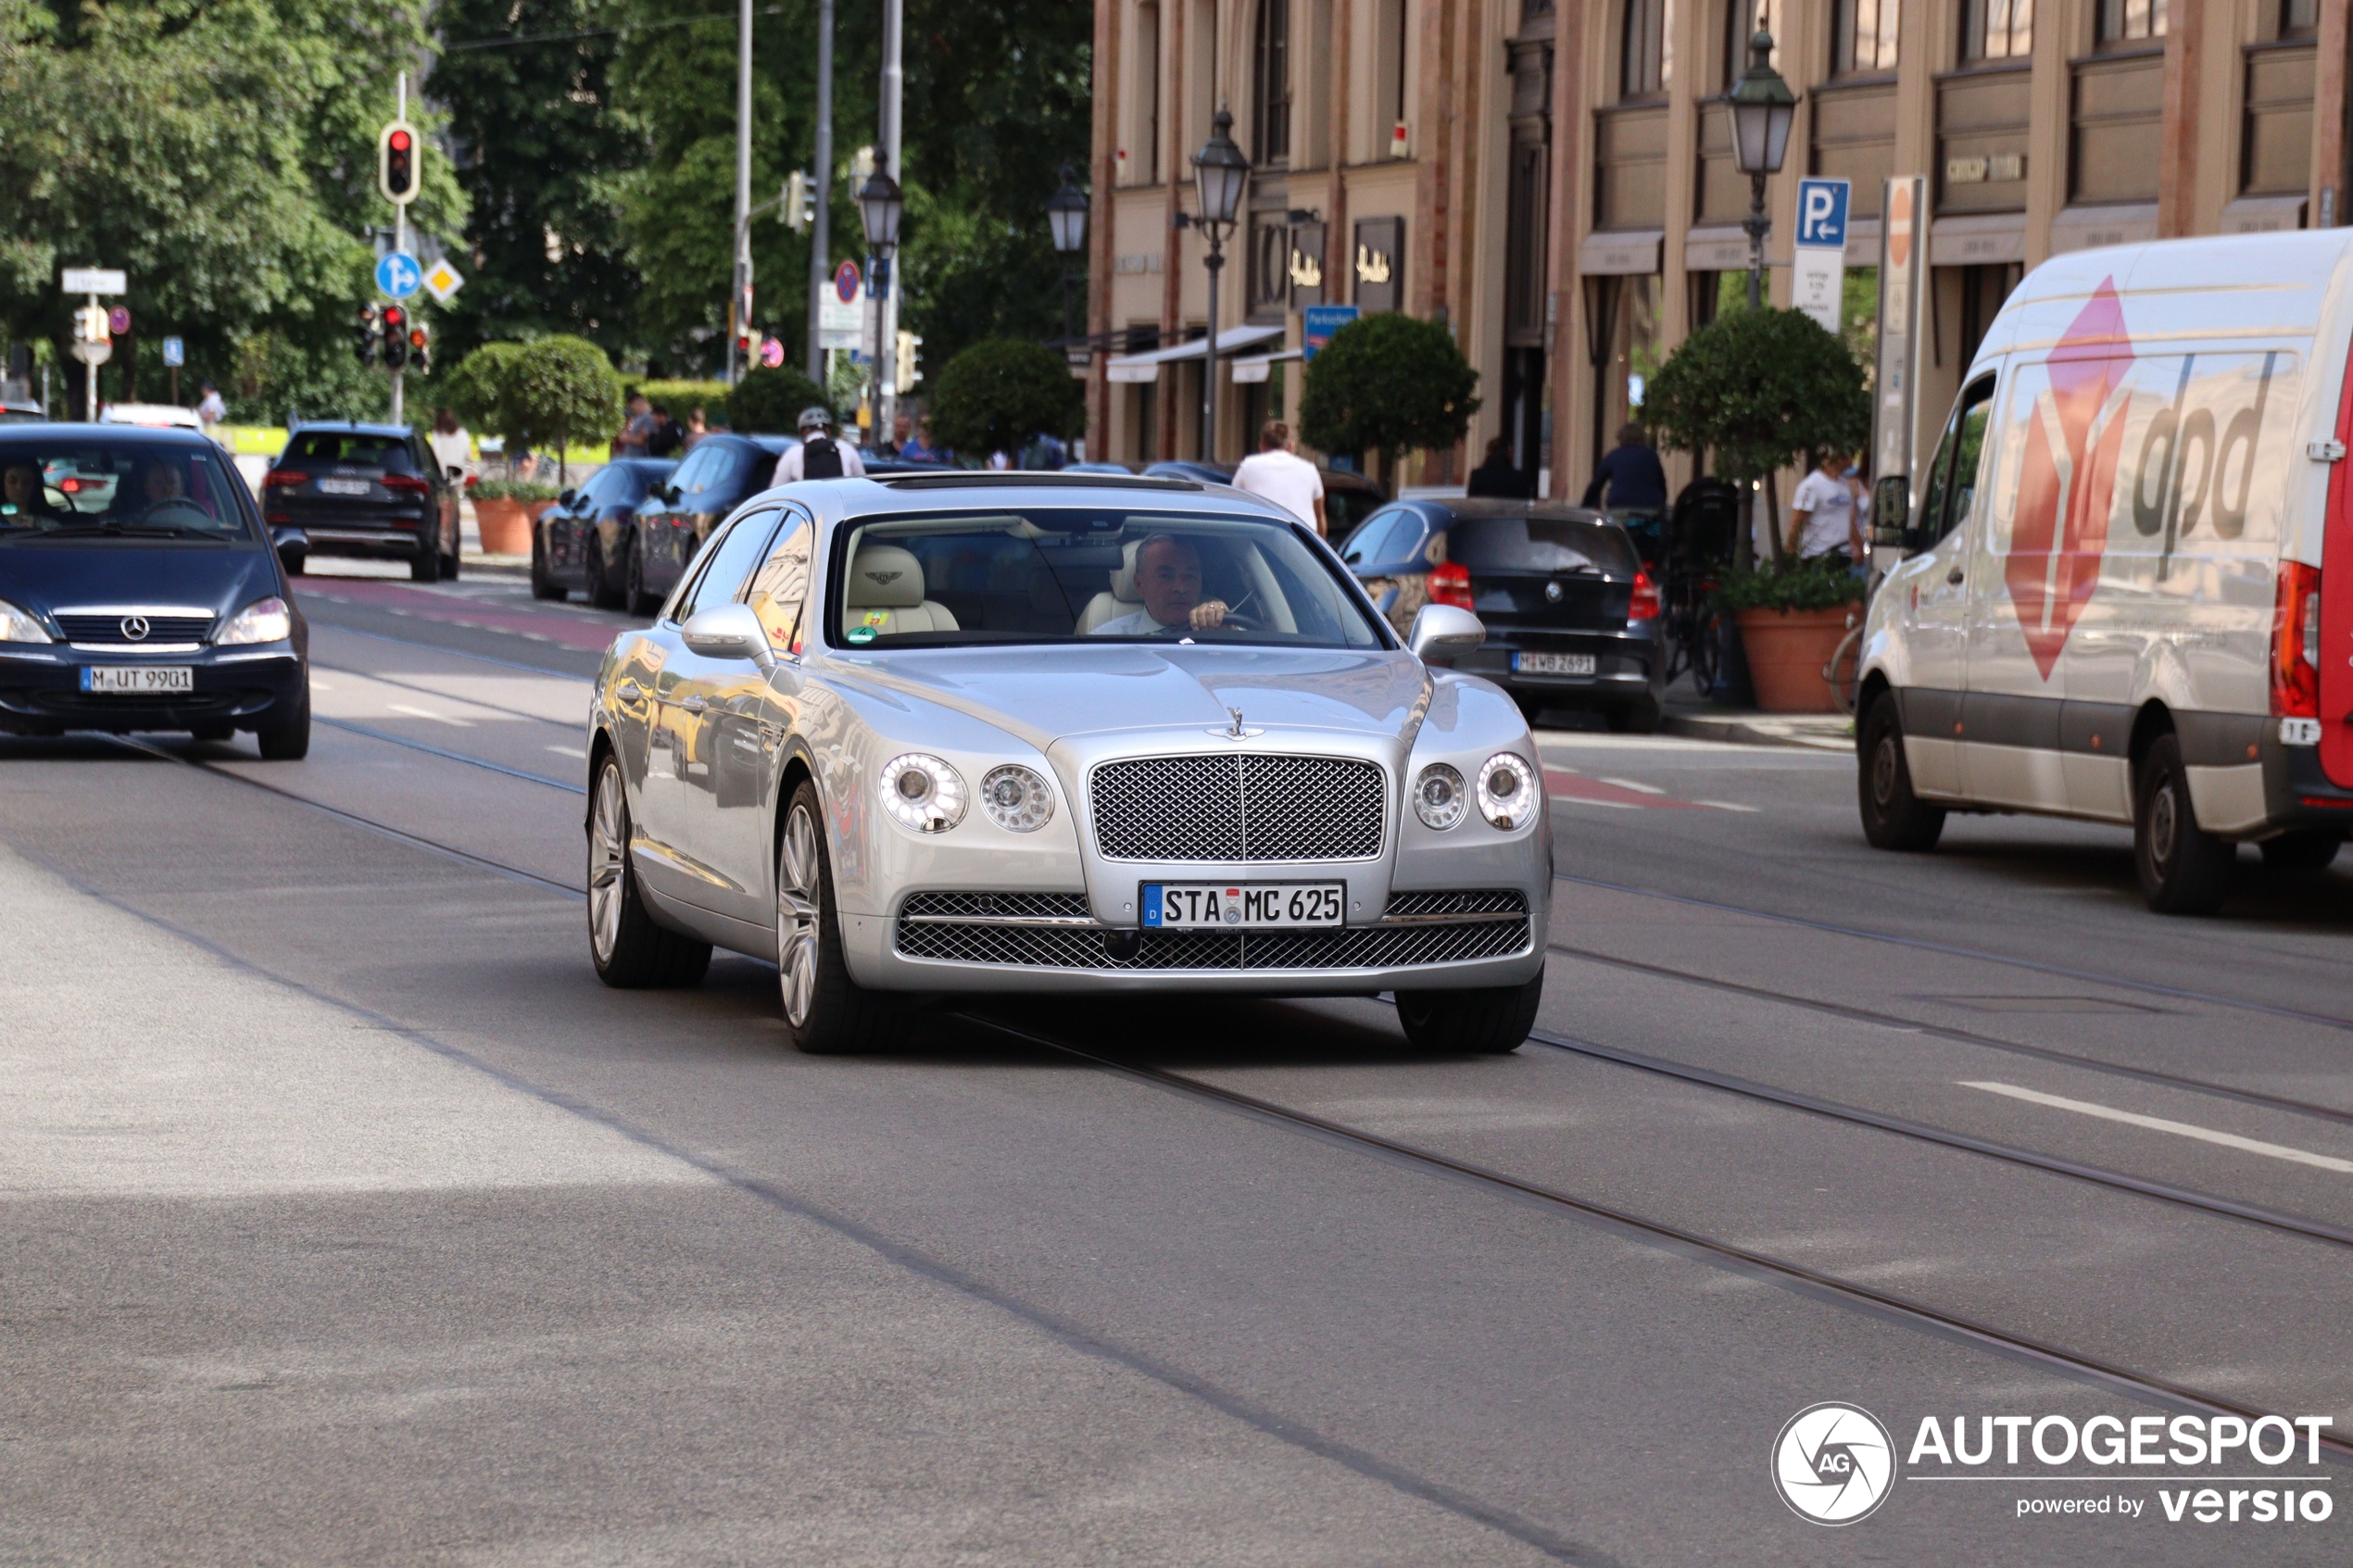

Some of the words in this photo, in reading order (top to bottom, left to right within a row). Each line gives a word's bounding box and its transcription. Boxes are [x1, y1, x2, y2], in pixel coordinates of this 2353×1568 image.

[1804, 187, 1834, 239] P
[2133, 352, 2277, 582] dpd
[93, 671, 104, 686] M
[117, 671, 140, 687] UT
[145, 671, 190, 687] 9901
[1520, 655, 1529, 667] M
[1539, 655, 1555, 670] WB
[1558, 657, 1592, 672] 2691
[1149, 909, 1157, 919] D
[1165, 890, 1220, 922] STA
[1244, 890, 1280, 922] MC
[1289, 889, 1340, 921] 625
